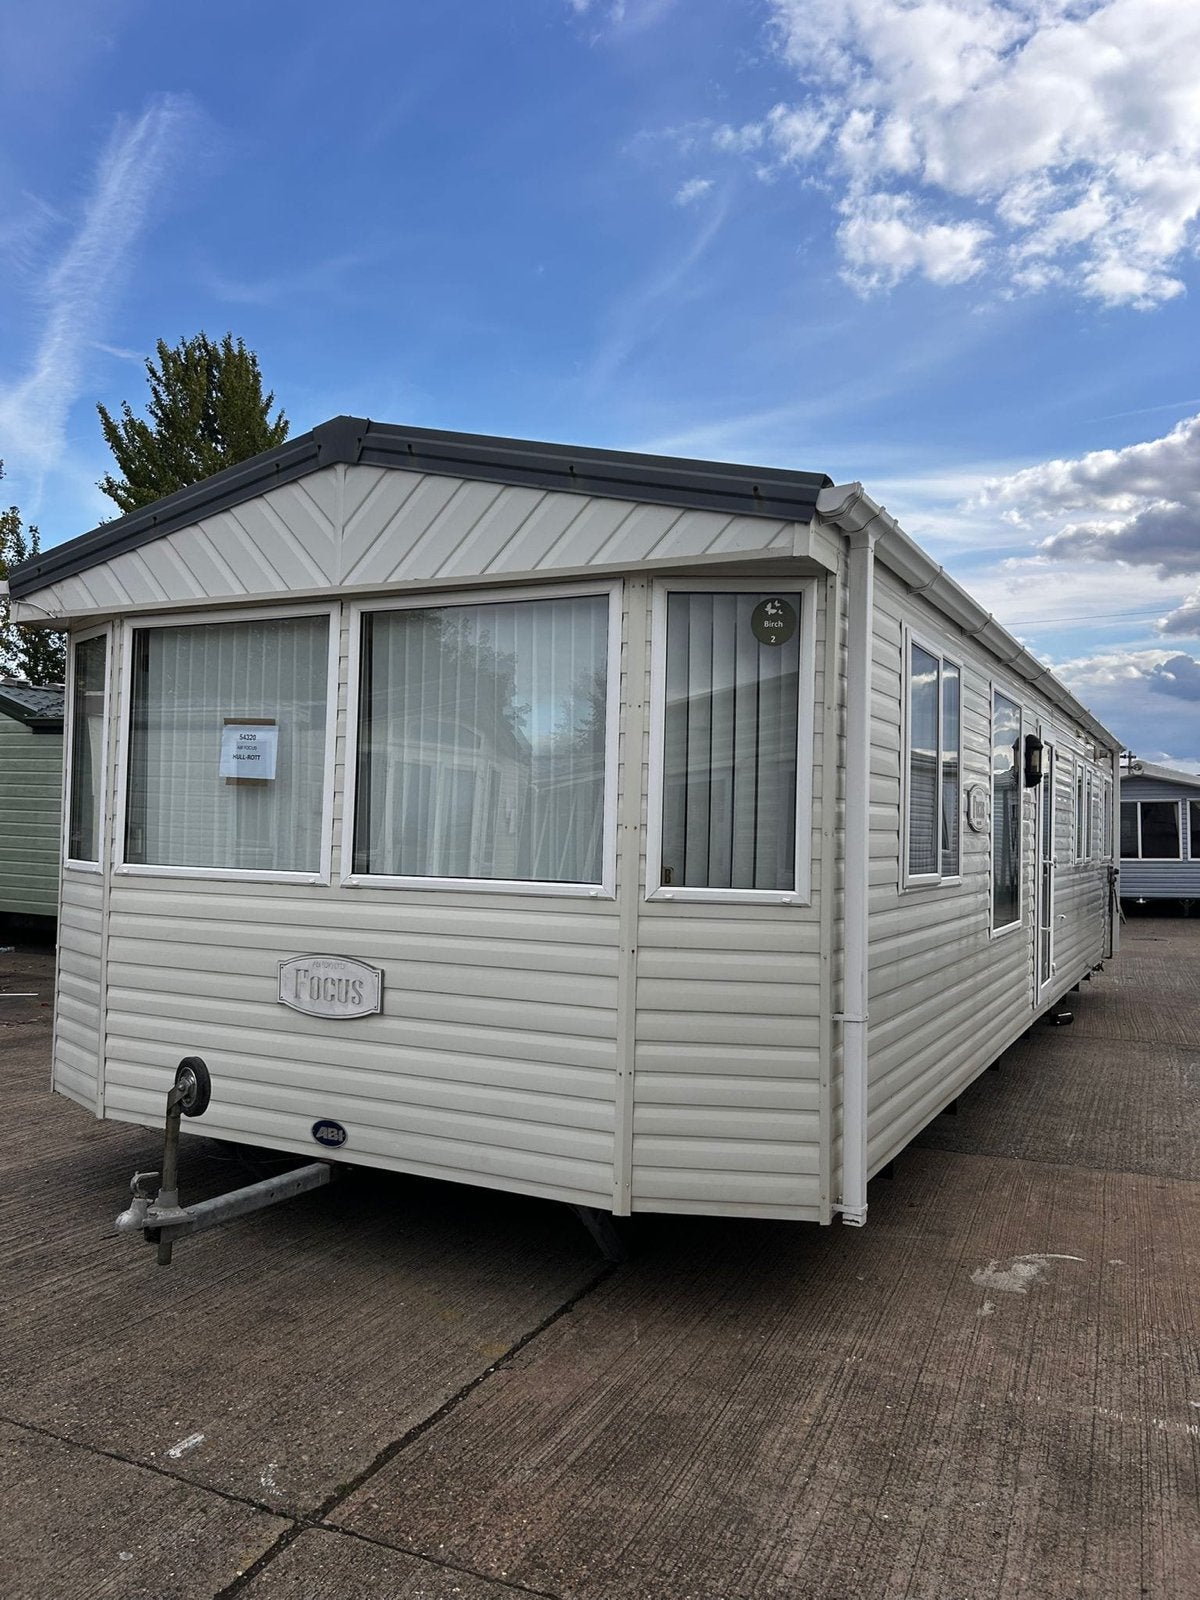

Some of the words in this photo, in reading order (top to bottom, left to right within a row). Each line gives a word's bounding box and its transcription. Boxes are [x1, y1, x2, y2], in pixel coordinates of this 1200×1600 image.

[764, 620, 783, 628] Birch
[770, 635, 776, 643] 2
[239, 733, 257, 741] 54320
[294, 968, 364, 1006] FOCUS
[315, 1126, 344, 1142] ABI
